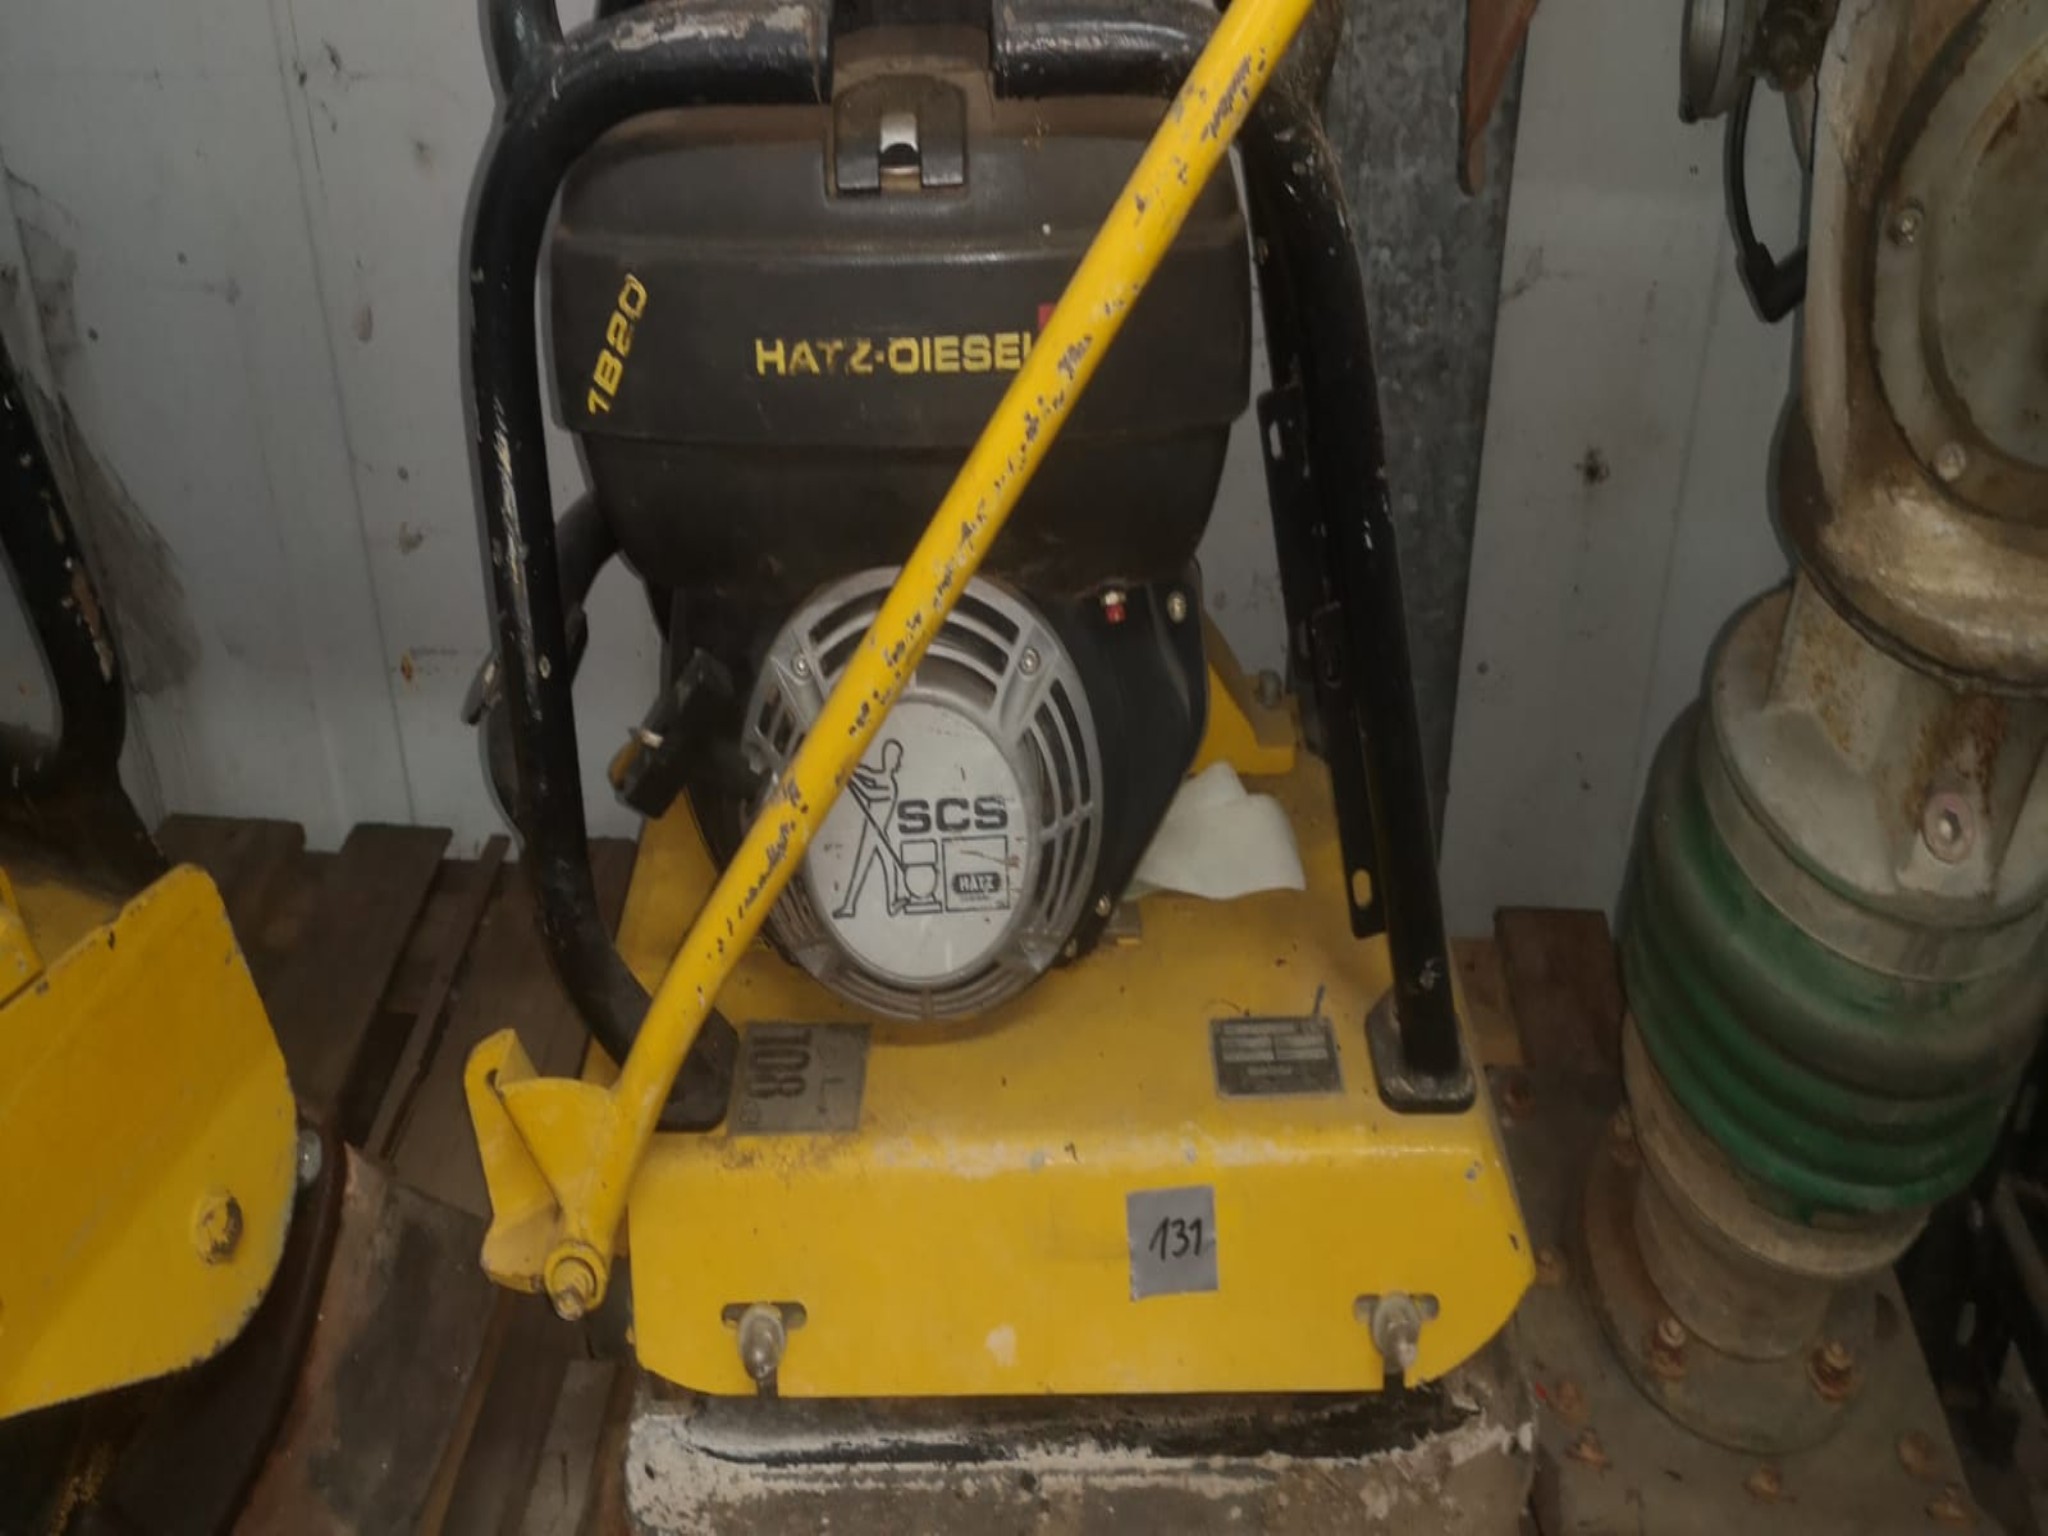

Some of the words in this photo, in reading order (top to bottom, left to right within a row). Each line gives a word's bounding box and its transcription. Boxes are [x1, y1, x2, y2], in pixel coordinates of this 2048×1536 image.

[587, 273, 648, 415] 1B20
[897, 797, 1008, 834] SCS
[1148, 1216, 1203, 1262] 131
